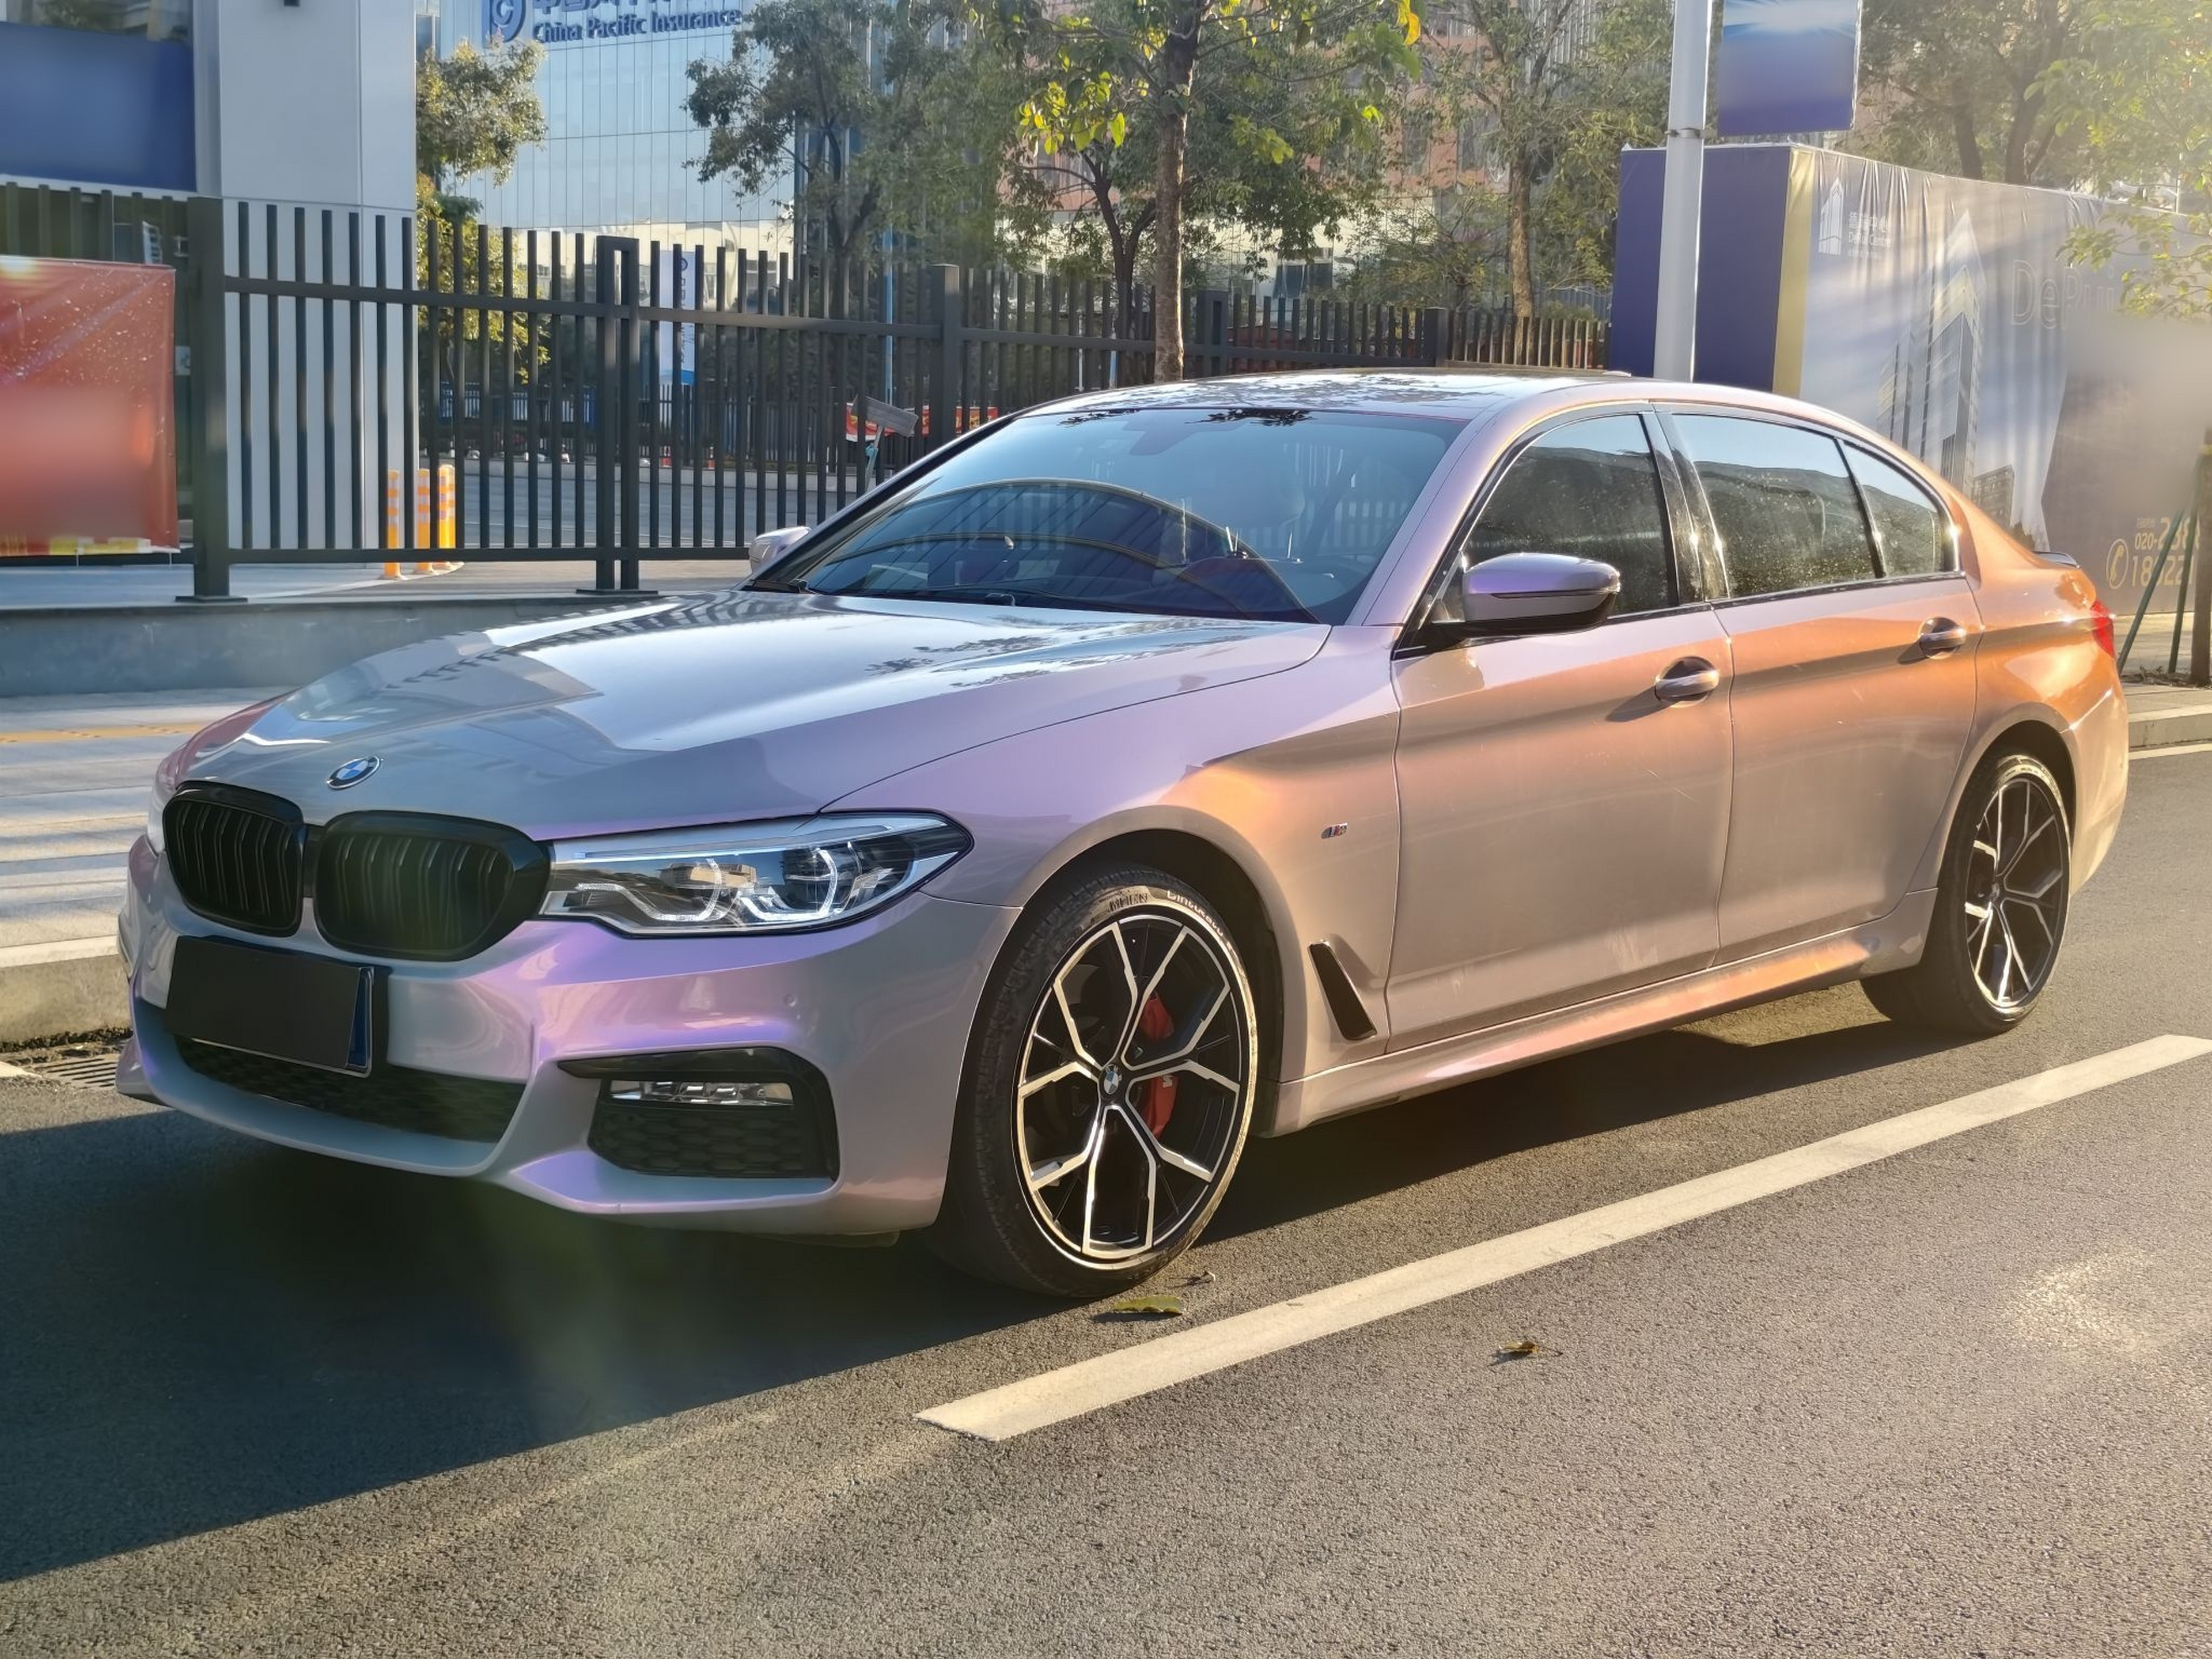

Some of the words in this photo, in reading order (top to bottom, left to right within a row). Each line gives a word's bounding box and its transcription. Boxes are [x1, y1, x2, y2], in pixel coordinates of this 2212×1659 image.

[533, 22, 583, 43] China
[588, 14, 647, 39] Pacific
[652, 9, 743, 33] Insurance
